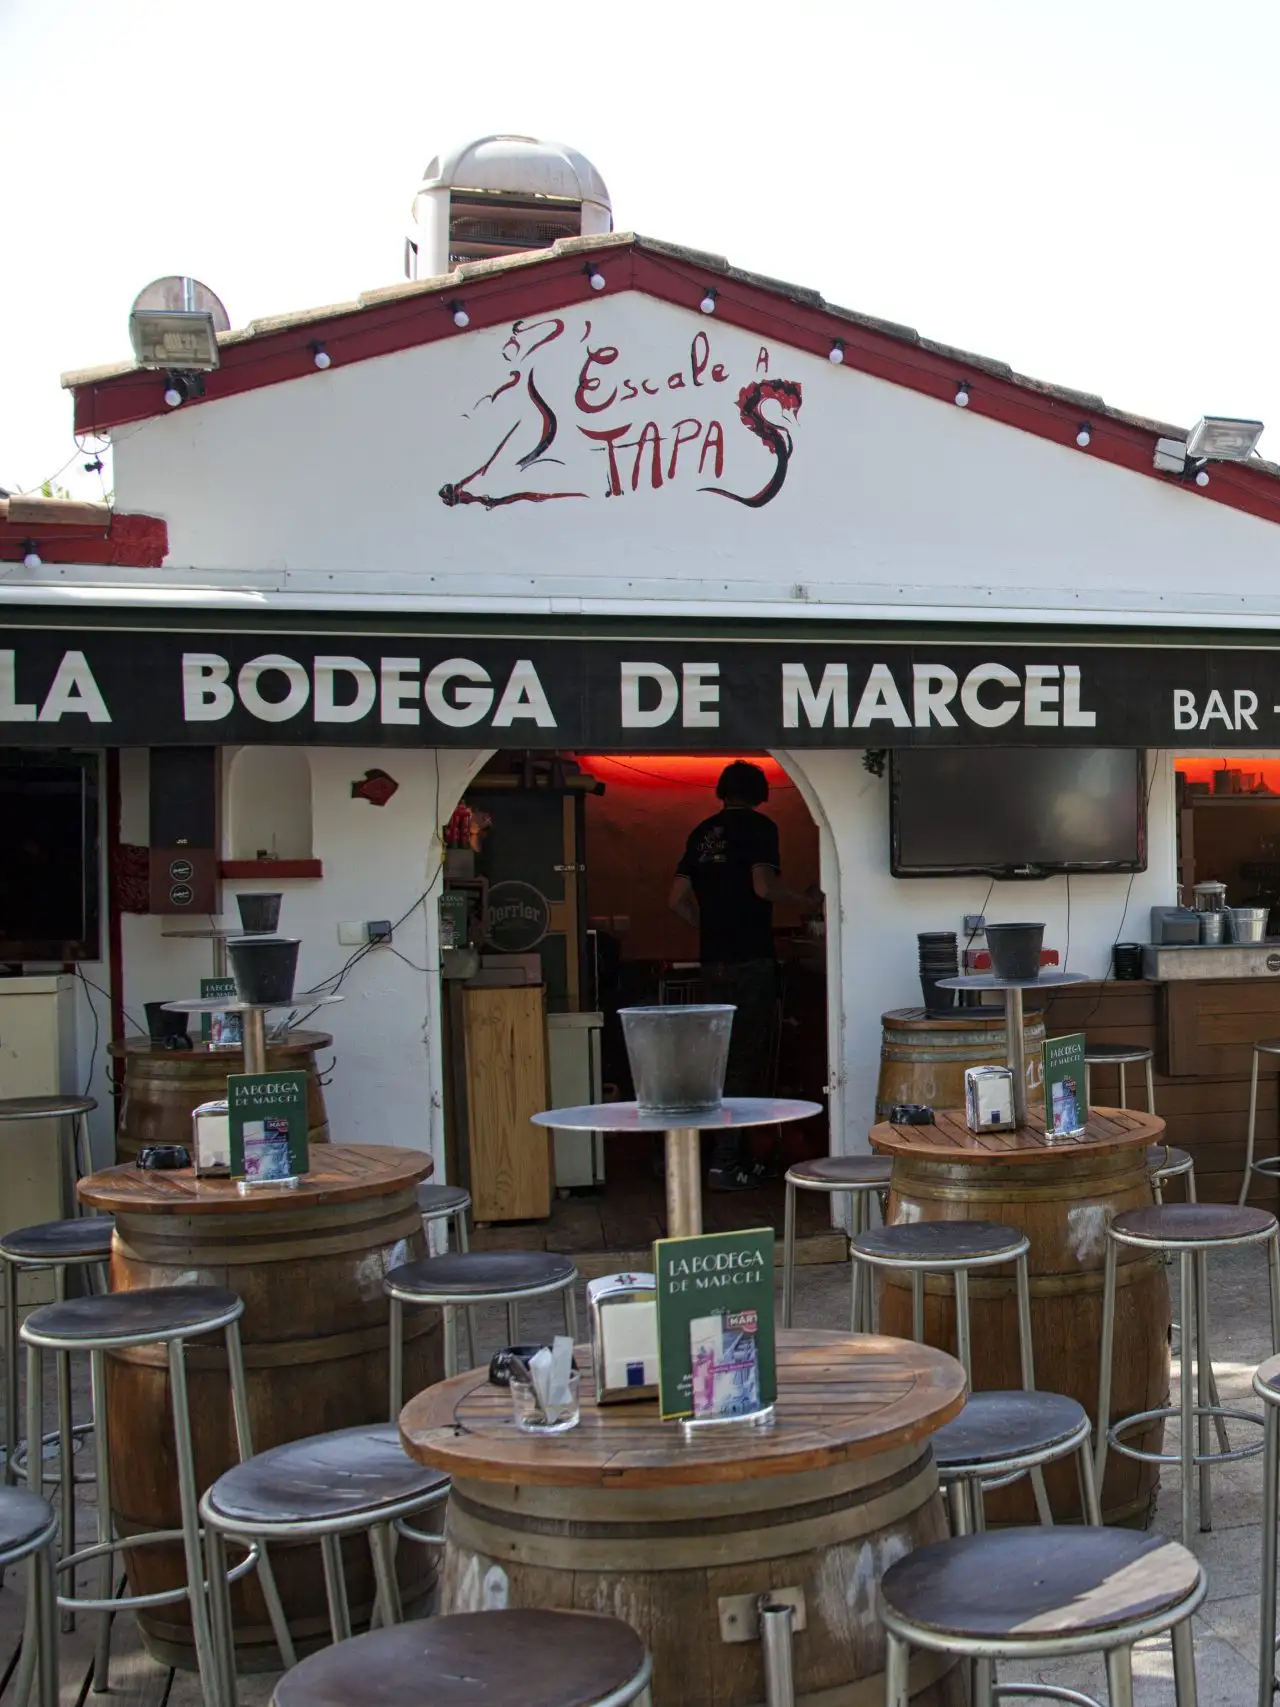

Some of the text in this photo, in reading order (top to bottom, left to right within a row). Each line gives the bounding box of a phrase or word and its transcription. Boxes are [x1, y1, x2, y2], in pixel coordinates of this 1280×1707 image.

[576, 377, 803, 508] TAPAS
[0, 649, 1096, 728] LA BODEGA DE MARCEL
[1173, 689, 1259, 731] BAR
[235, 1081, 299, 1097] LA BODEGA
[253, 1094, 299, 1105] MARCEL
[669, 1249, 765, 1278] LA BODEGA
[669, 1270, 764, 1294] DE MARCEL
